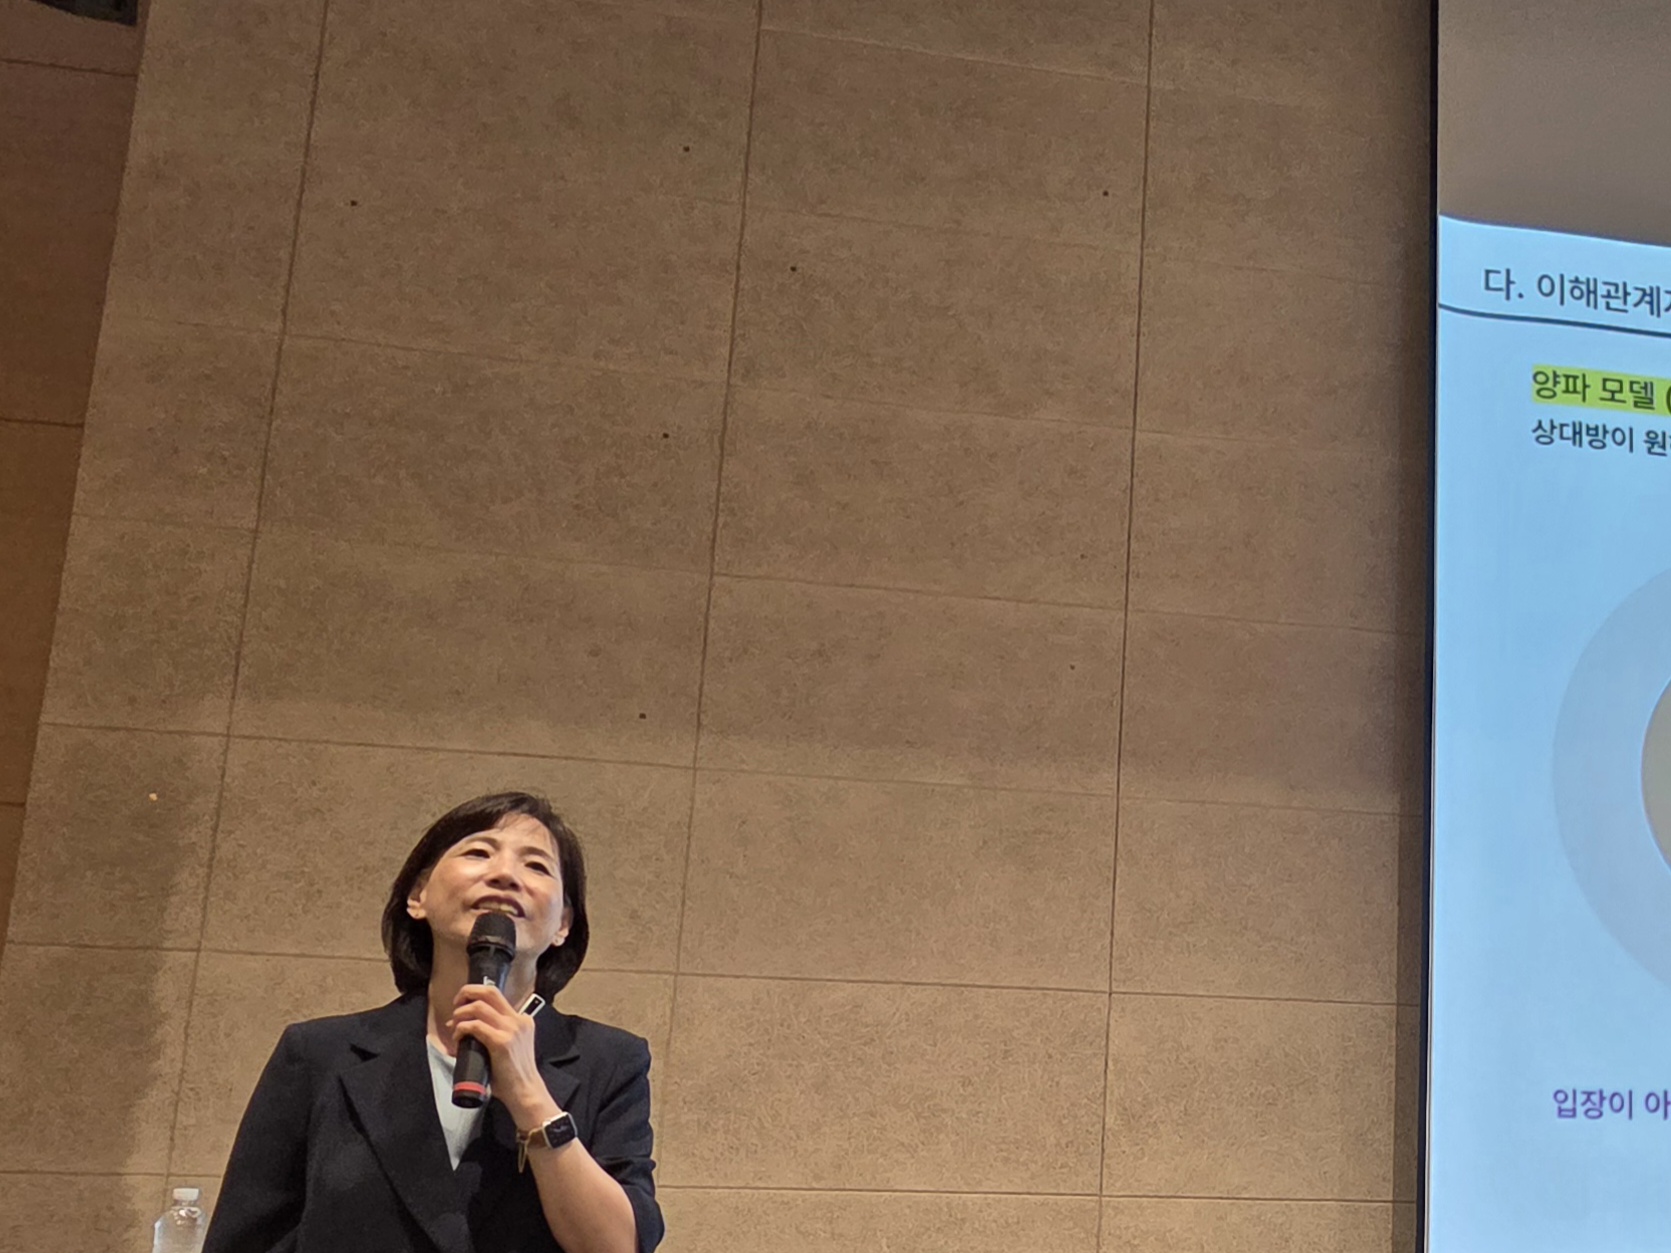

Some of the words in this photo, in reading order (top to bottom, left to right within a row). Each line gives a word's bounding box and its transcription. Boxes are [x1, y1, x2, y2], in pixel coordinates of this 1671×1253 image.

[1483, 268, 1524, 301] 다.
[1532, 370, 1590, 402] 양파
[1599, 377, 1656, 410] 모델
[1532, 419, 1635, 452] 상대방이
[1552, 1088, 1634, 1120] 입장이
